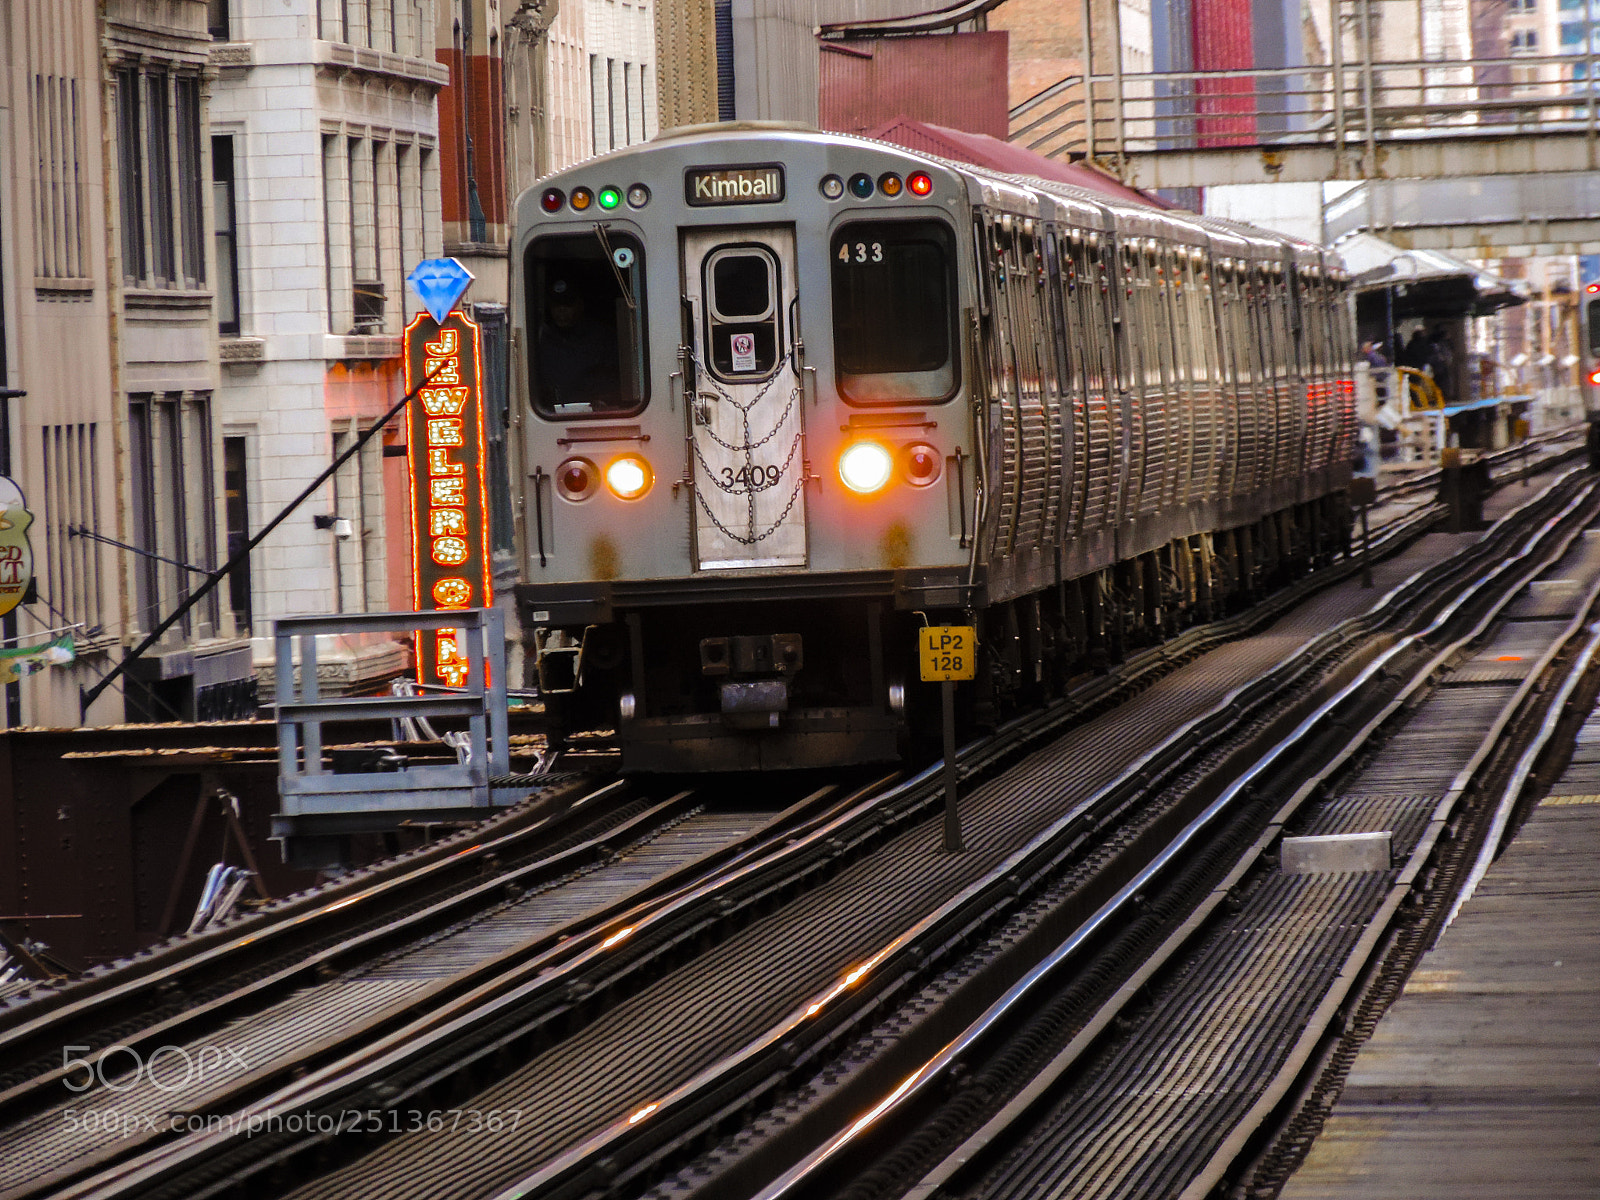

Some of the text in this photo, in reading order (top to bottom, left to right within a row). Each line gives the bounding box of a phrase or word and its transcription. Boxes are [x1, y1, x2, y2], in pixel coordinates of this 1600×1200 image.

[695, 173, 777, 198] Kimball
[838, 242, 883, 263] 433
[418, 328, 470, 566] JEWELERS
[721, 465, 780, 488] 3409
[929, 634, 964, 650] LP2
[931, 656, 963, 671] 128
